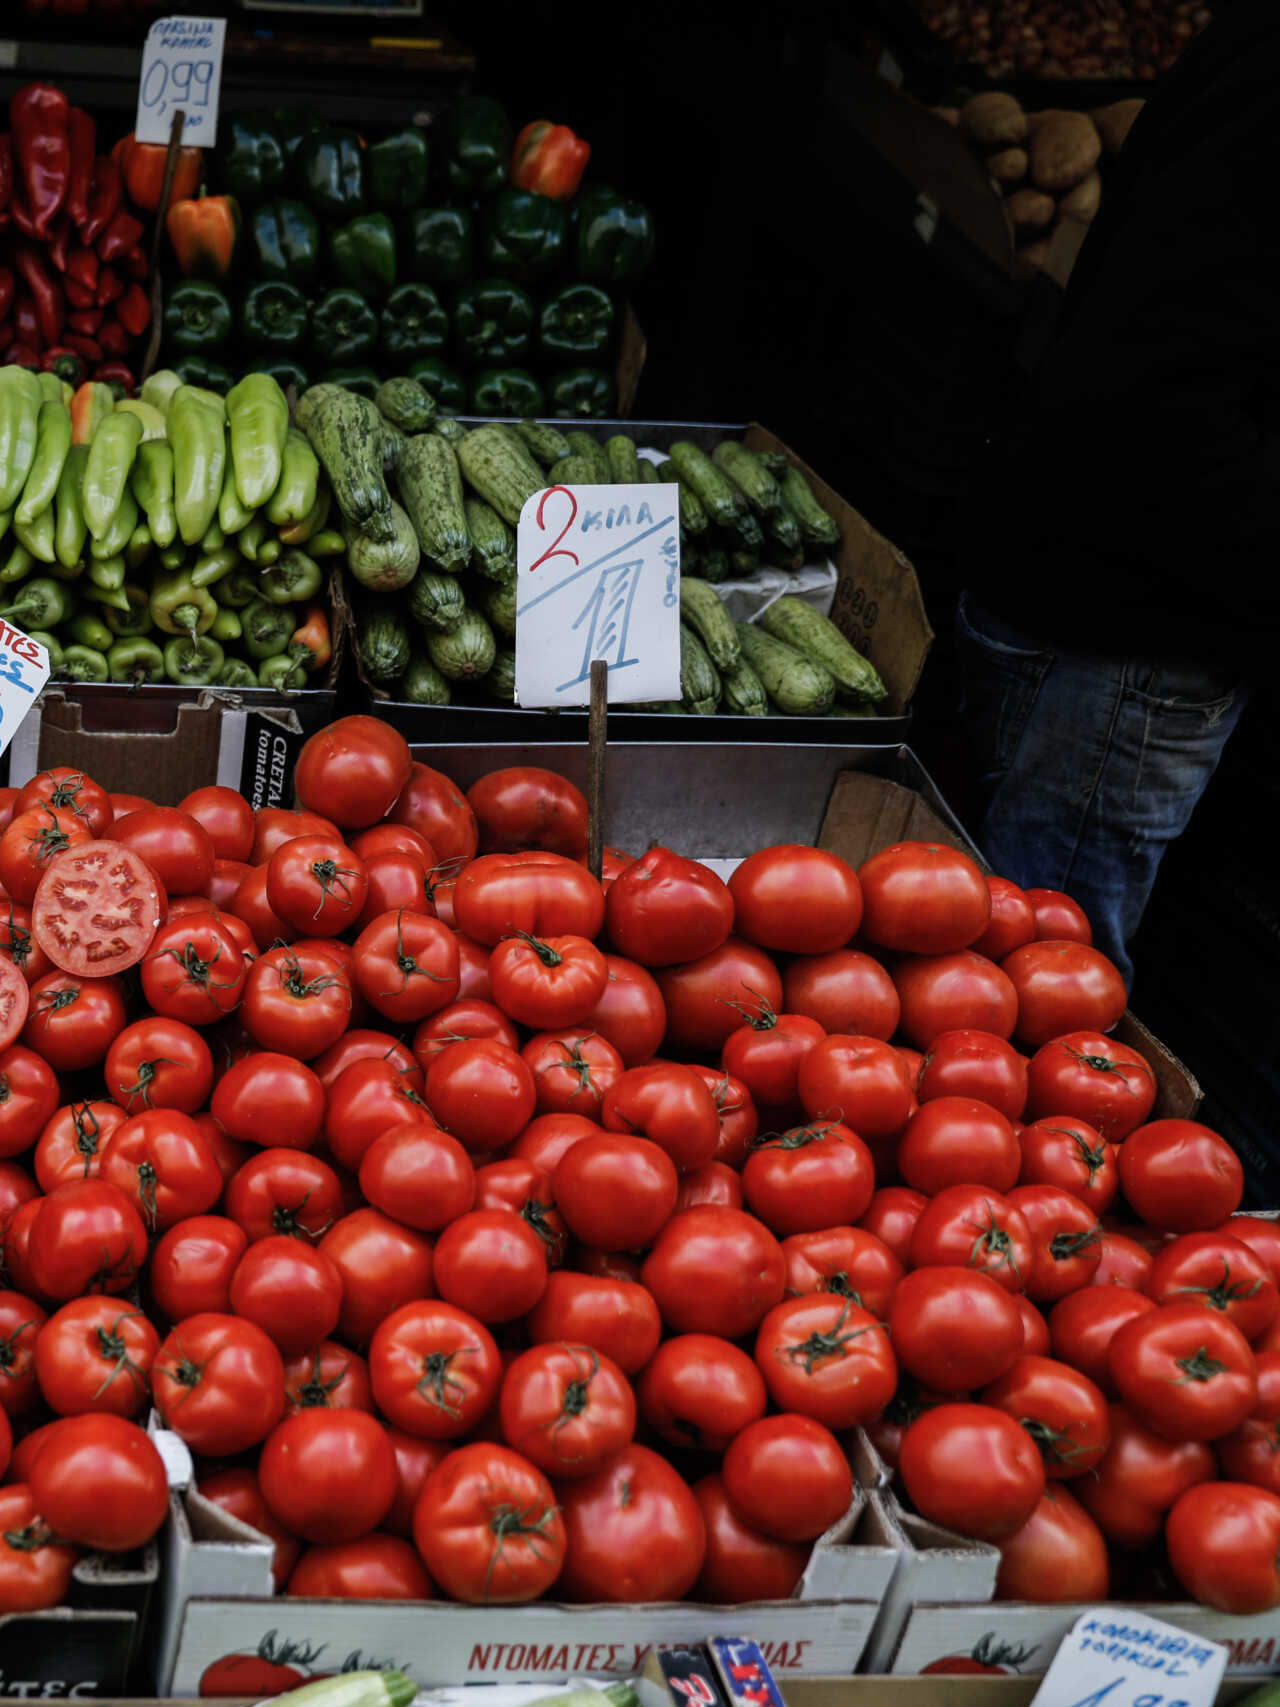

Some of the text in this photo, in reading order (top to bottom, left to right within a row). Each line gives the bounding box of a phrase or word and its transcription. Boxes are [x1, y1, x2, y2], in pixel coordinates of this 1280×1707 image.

[142, 58, 214, 116] 0,99
[529, 485, 654, 572] 2 ΚΙΛΑ
[468, 1643, 625, 1671] ΝΤΟΜΑΤΕΣ
